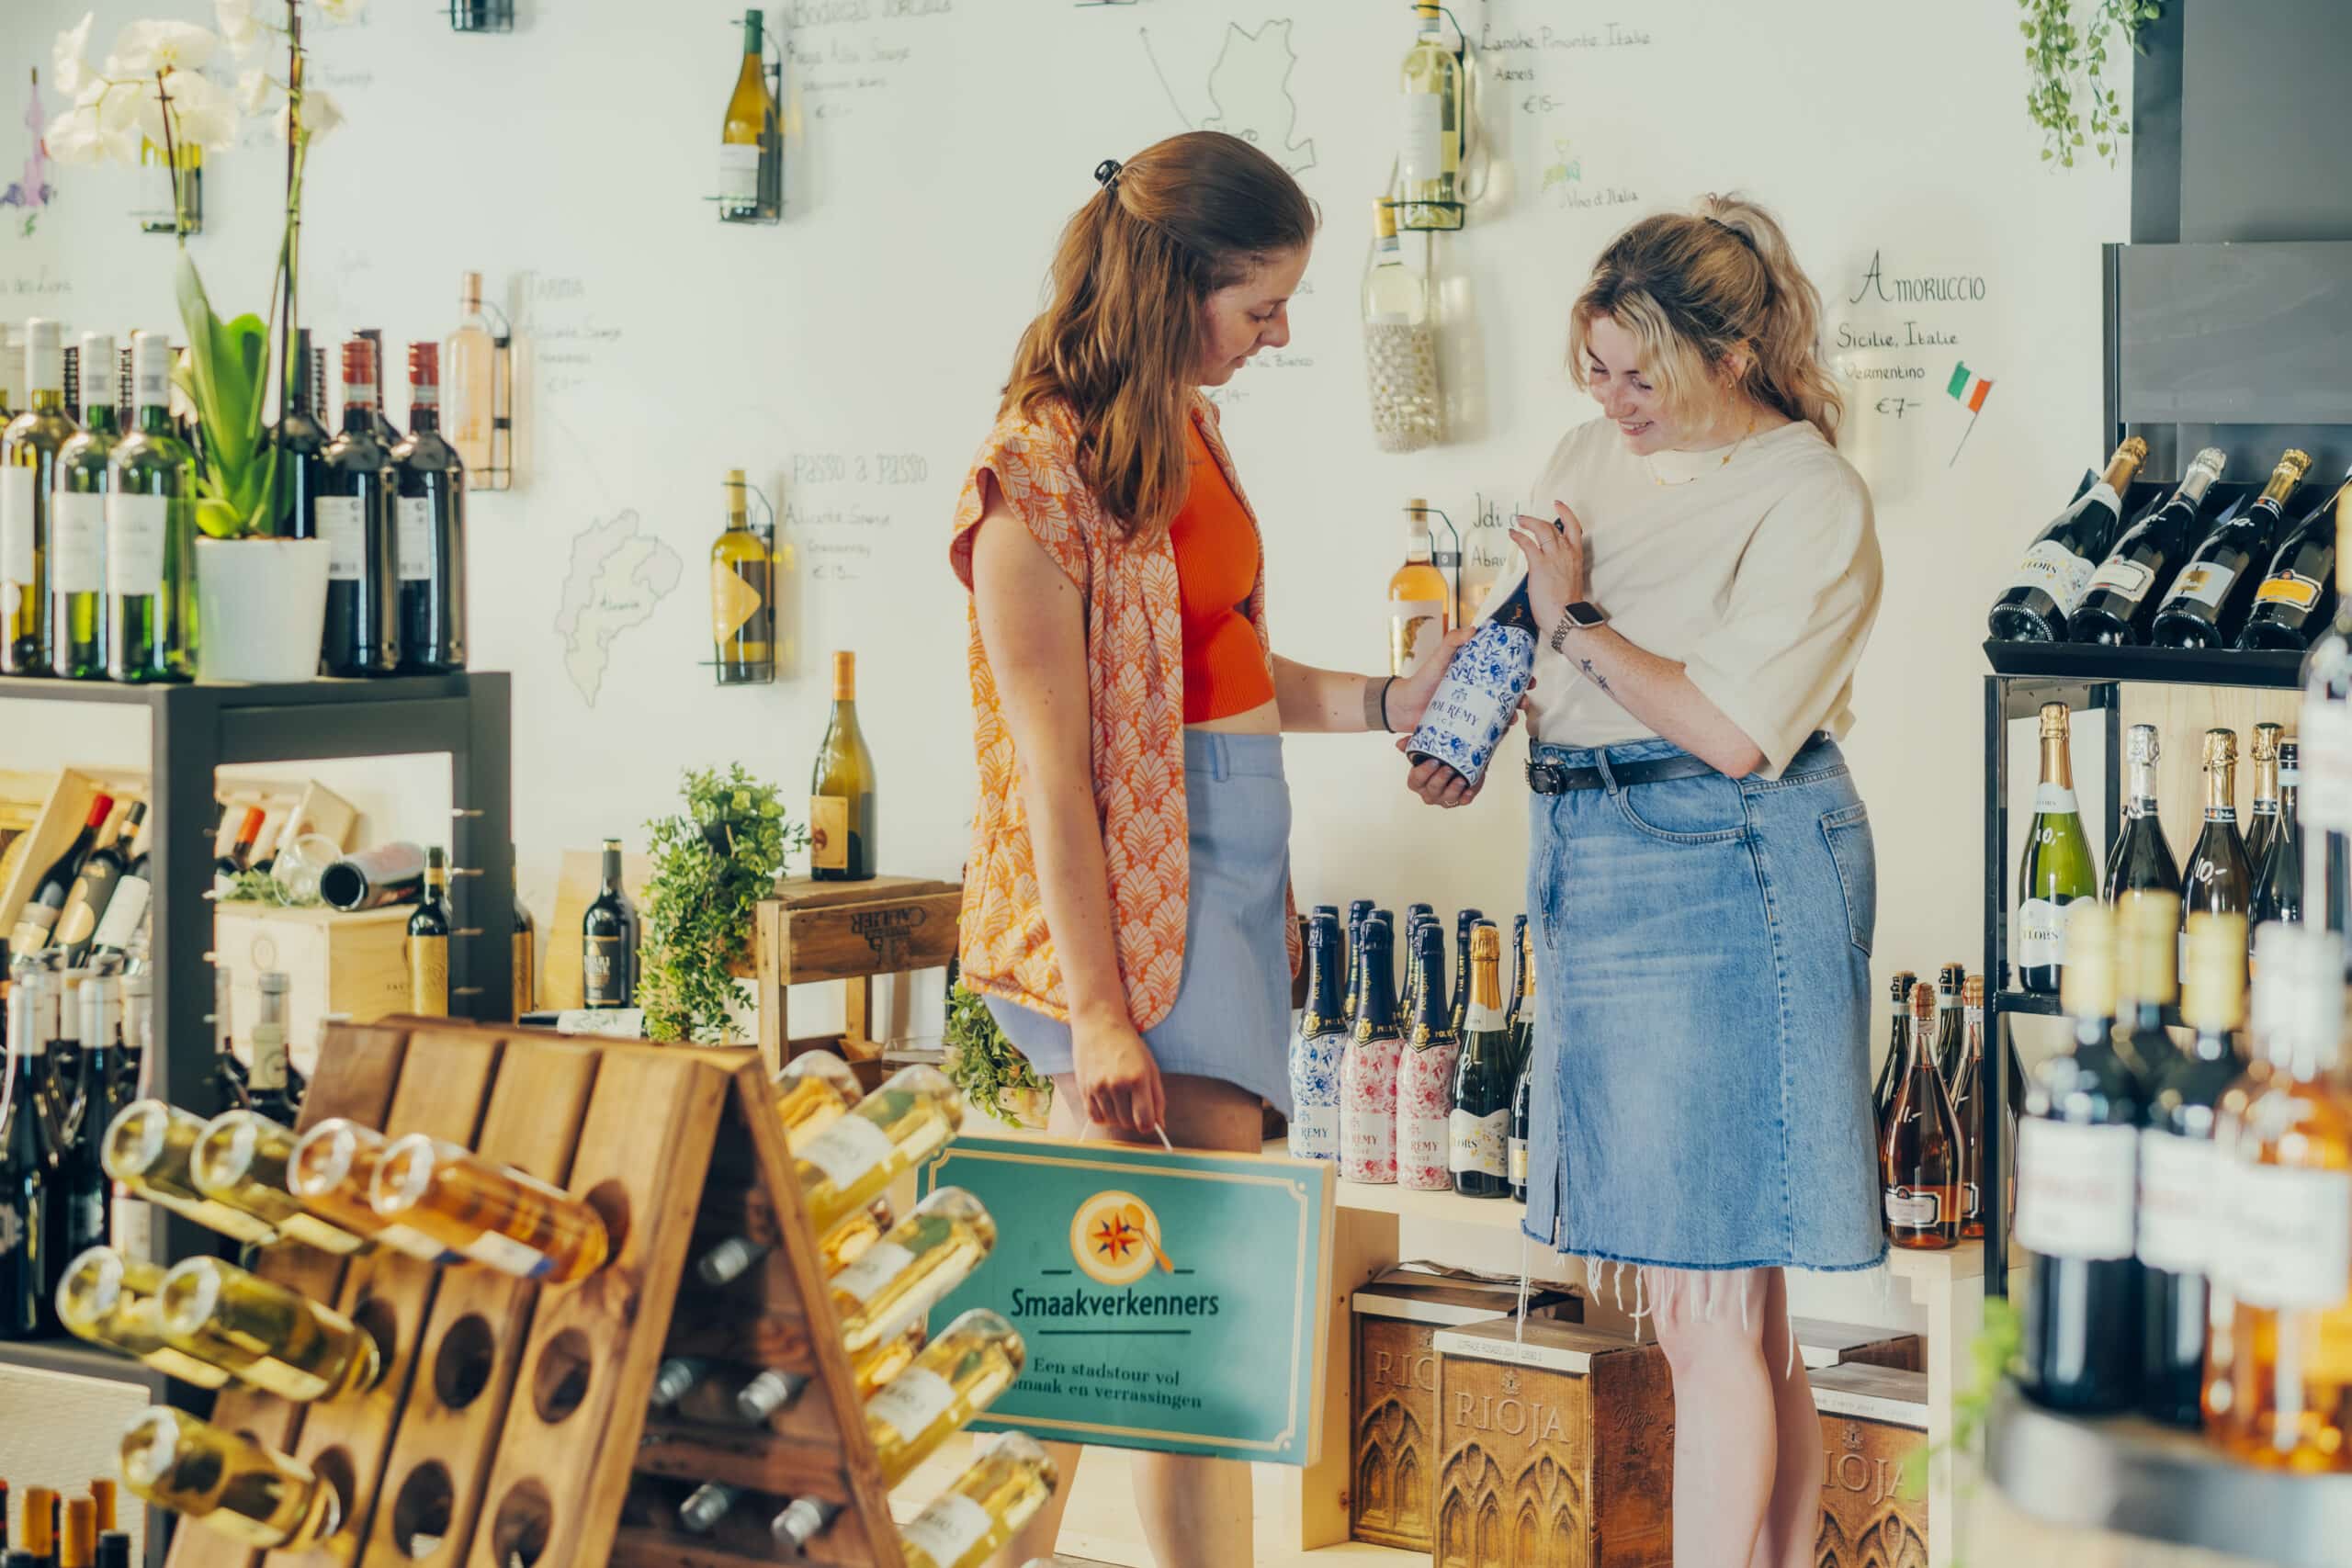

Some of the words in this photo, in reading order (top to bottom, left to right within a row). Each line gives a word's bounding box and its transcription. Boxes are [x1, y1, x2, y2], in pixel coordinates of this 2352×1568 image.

[1904, 321, 1959, 346] Italie
[1301, 1125, 1329, 1140] REMY
[1411, 1140, 1440, 1153] REMY
[1011, 1287, 1220, 1317] Smaakverkenners
[1034, 1357, 1066, 1375] Een
[1071, 1362, 1150, 1383] stadstour
[1156, 1370, 1181, 1387] vol
[1374, 1350, 1434, 1393] RIO
[1068, 1383, 1089, 1398] en
[1094, 1385, 1203, 1411] verrassingen
[1454, 1390, 1571, 1447] RIOJA
